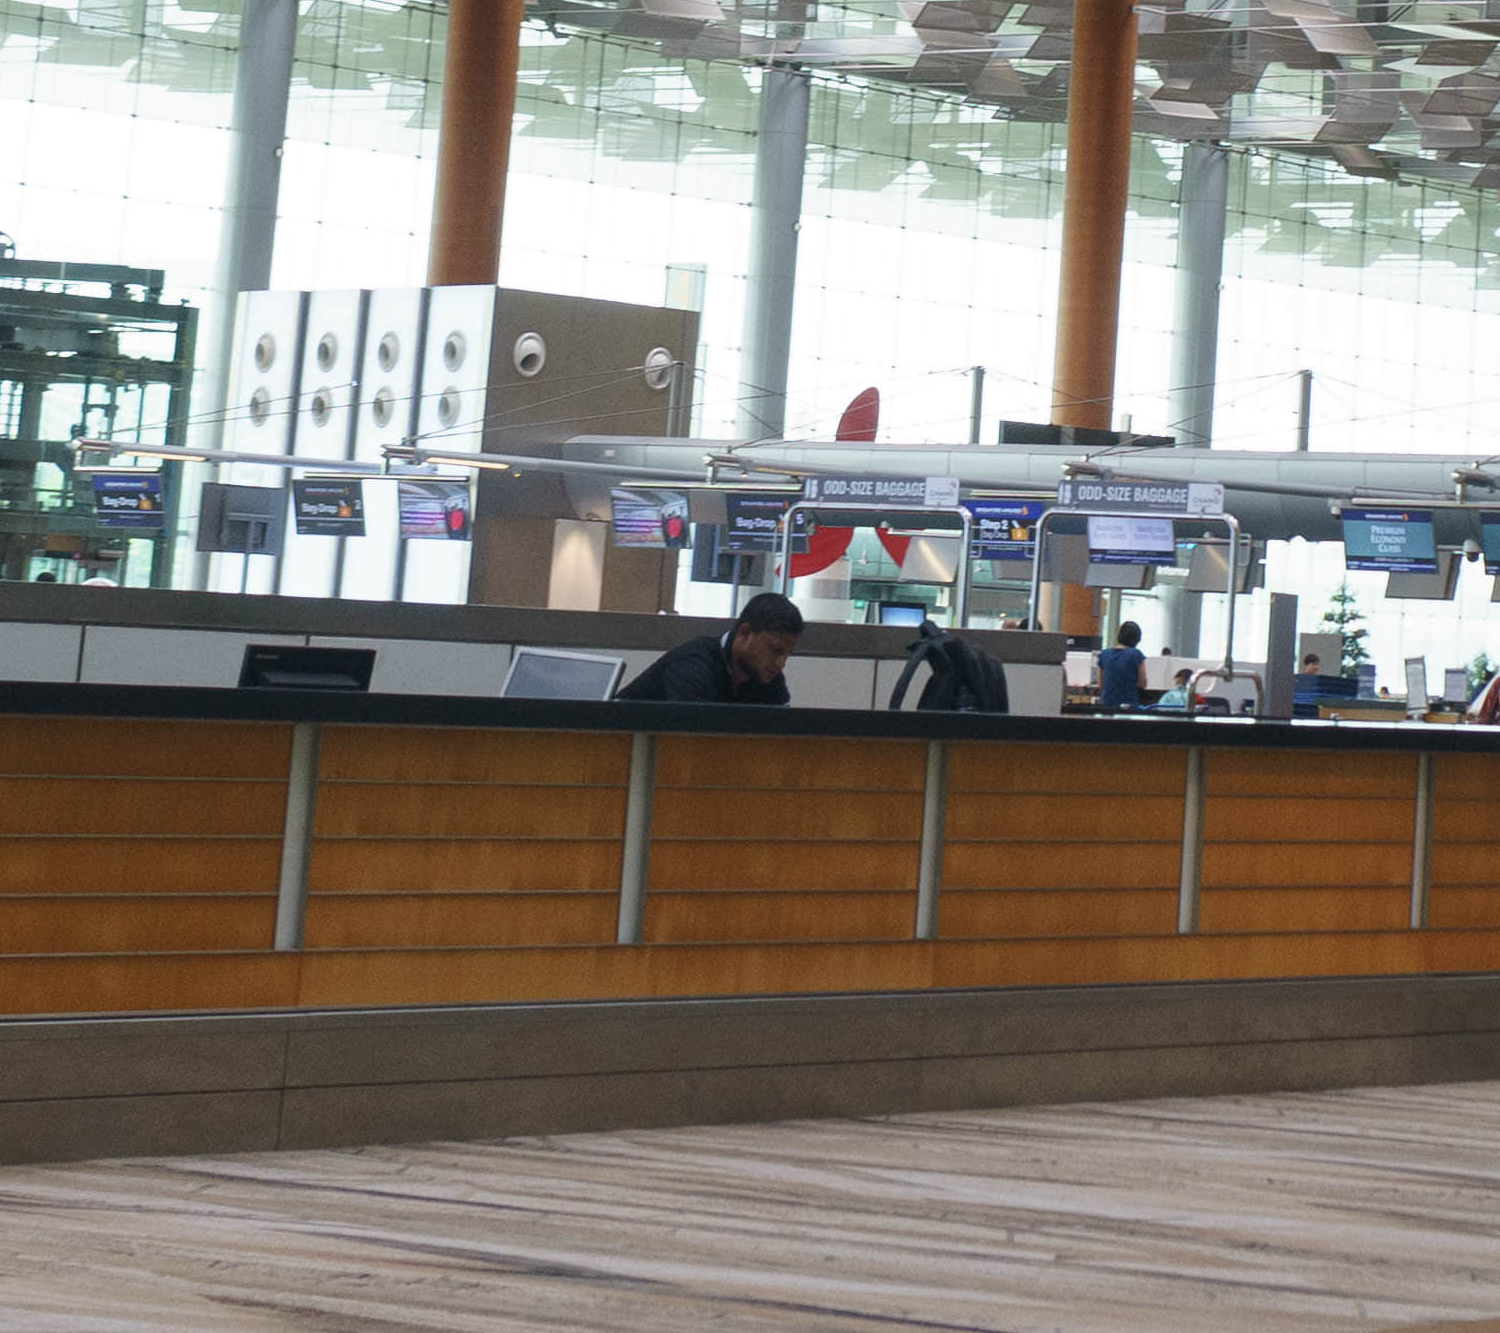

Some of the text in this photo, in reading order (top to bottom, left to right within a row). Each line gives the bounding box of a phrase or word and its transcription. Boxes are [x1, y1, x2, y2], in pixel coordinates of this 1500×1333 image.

[823, 480, 925, 497] ODD-SIZE BAGGAGE
[1077, 485, 1187, 504] ODD-SIZE BAGGAGE
[735, 516, 777, 530] Bag-Drop
[1001, 519, 1009, 530] 2
